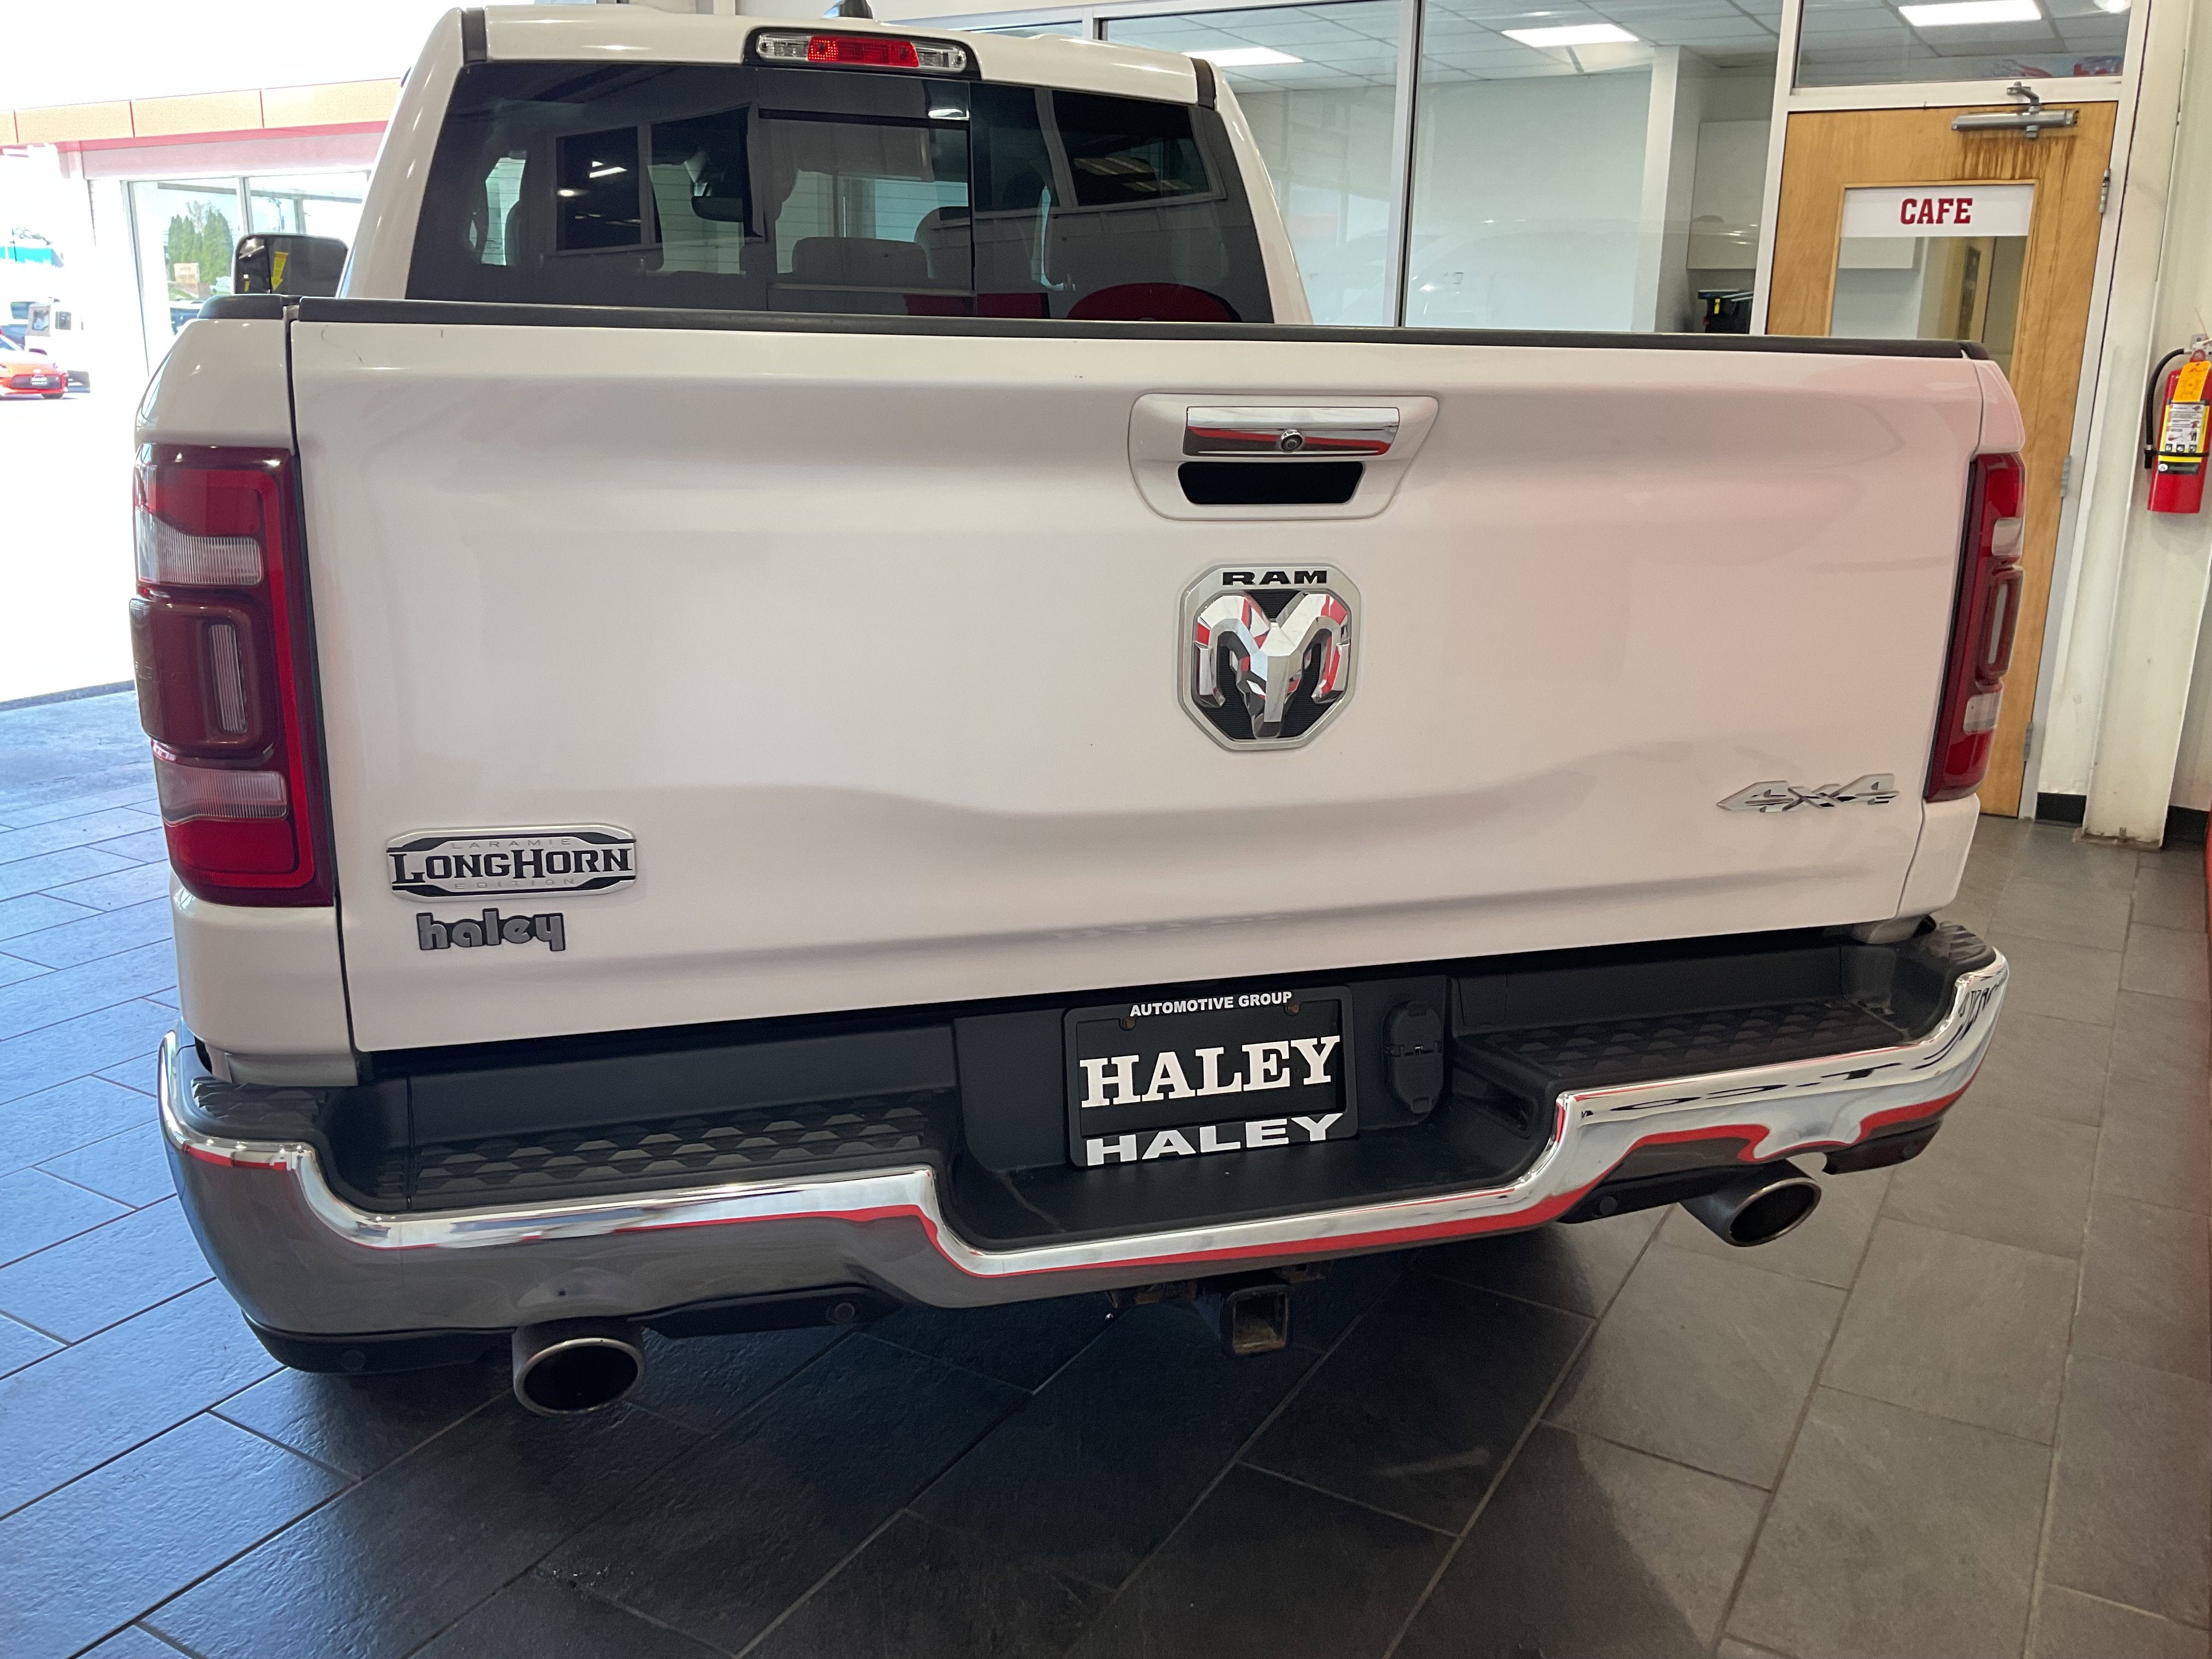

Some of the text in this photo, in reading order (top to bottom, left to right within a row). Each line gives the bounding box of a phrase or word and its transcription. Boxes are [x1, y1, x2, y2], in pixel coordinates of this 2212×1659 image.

[1900, 198, 1973, 224] CAFE
[1222, 571, 1327, 585] RAM
[451, 838, 571, 849] LARAMIE
[390, 848, 632, 884] LONGHORN
[455, 879, 575, 890] EDITION
[416, 909, 566, 951] haley
[1130, 991, 1292, 1017] AUTOMOTIVE GROUP
[1079, 1036, 1340, 1108] HALEY
[1086, 1113, 1343, 1166] HALEY
